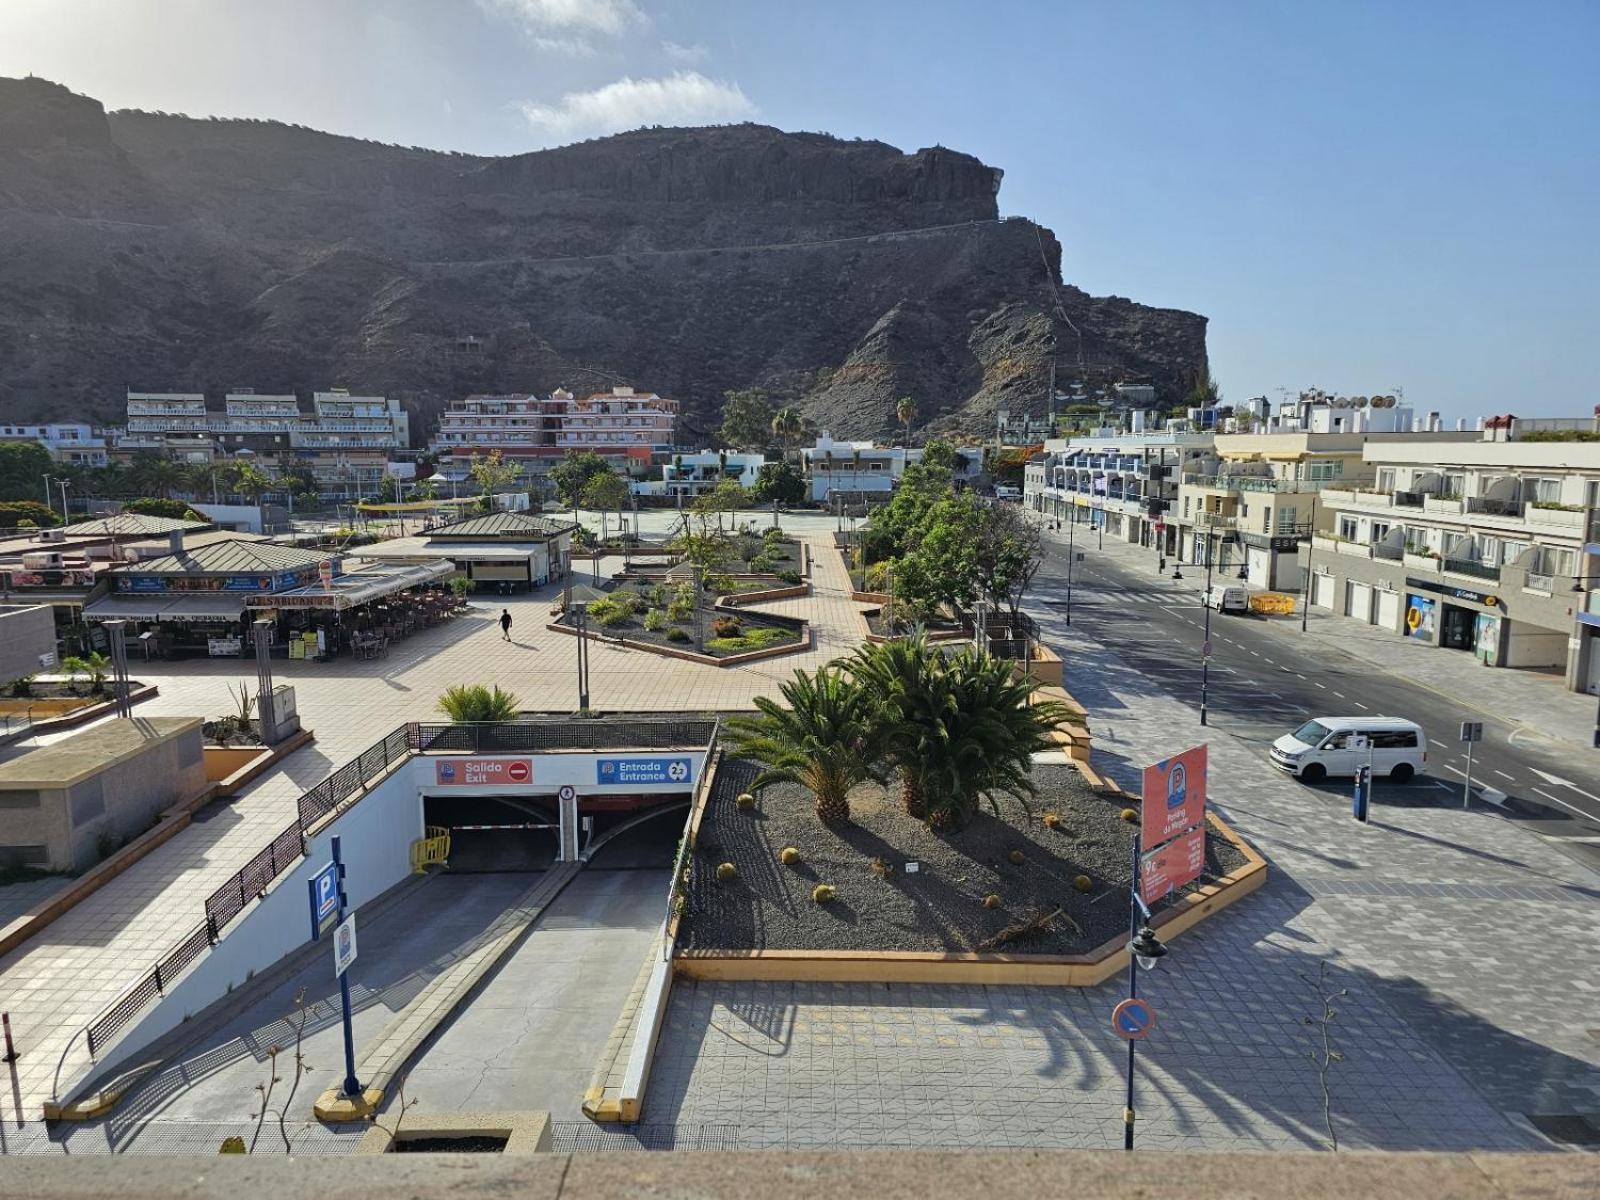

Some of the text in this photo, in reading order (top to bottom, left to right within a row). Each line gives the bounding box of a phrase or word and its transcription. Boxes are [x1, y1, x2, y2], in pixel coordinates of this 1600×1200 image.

[619, 762, 661, 771] Entrada
[465, 773, 487, 782] Exit
[619, 772, 666, 781] Entrance
[321, 875, 331, 900] P
